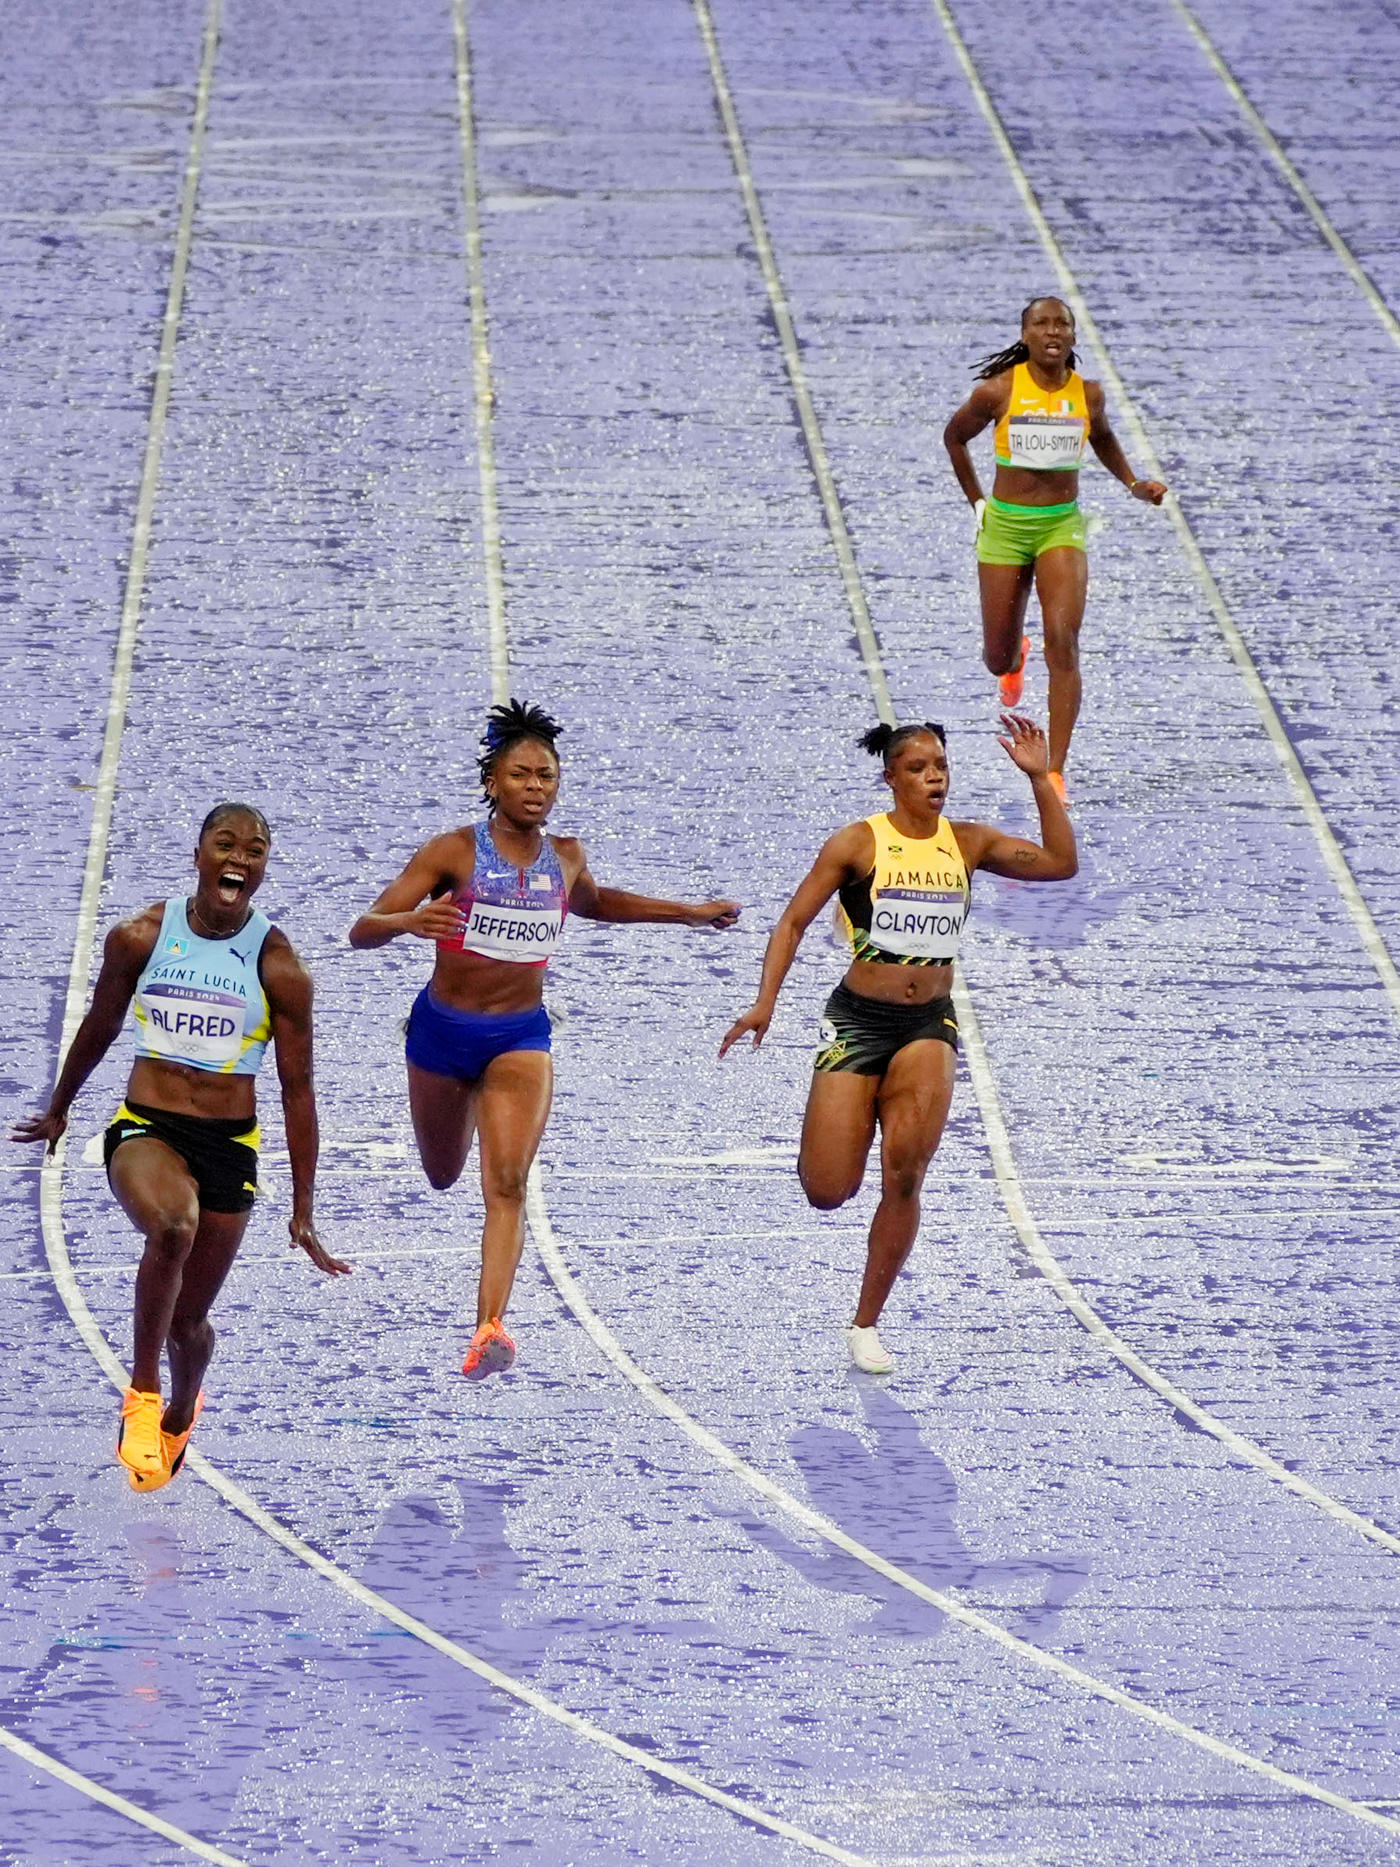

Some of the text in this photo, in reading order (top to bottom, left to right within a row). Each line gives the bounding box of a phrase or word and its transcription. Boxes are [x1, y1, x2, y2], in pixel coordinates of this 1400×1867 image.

[1011, 434, 1080, 451] TA LOU-SMITH
[883, 871, 964, 889] JAMAICA
[500, 898, 524, 907] PARIS
[901, 891, 925, 899] PARIS
[470, 913, 559, 942] JEFFERSON
[876, 911, 962, 936] CLAYTON
[151, 967, 247, 997] SAINT LUCIA
[167, 988, 194, 998] PARIS
[151, 1008, 236, 1038] ALFRED
